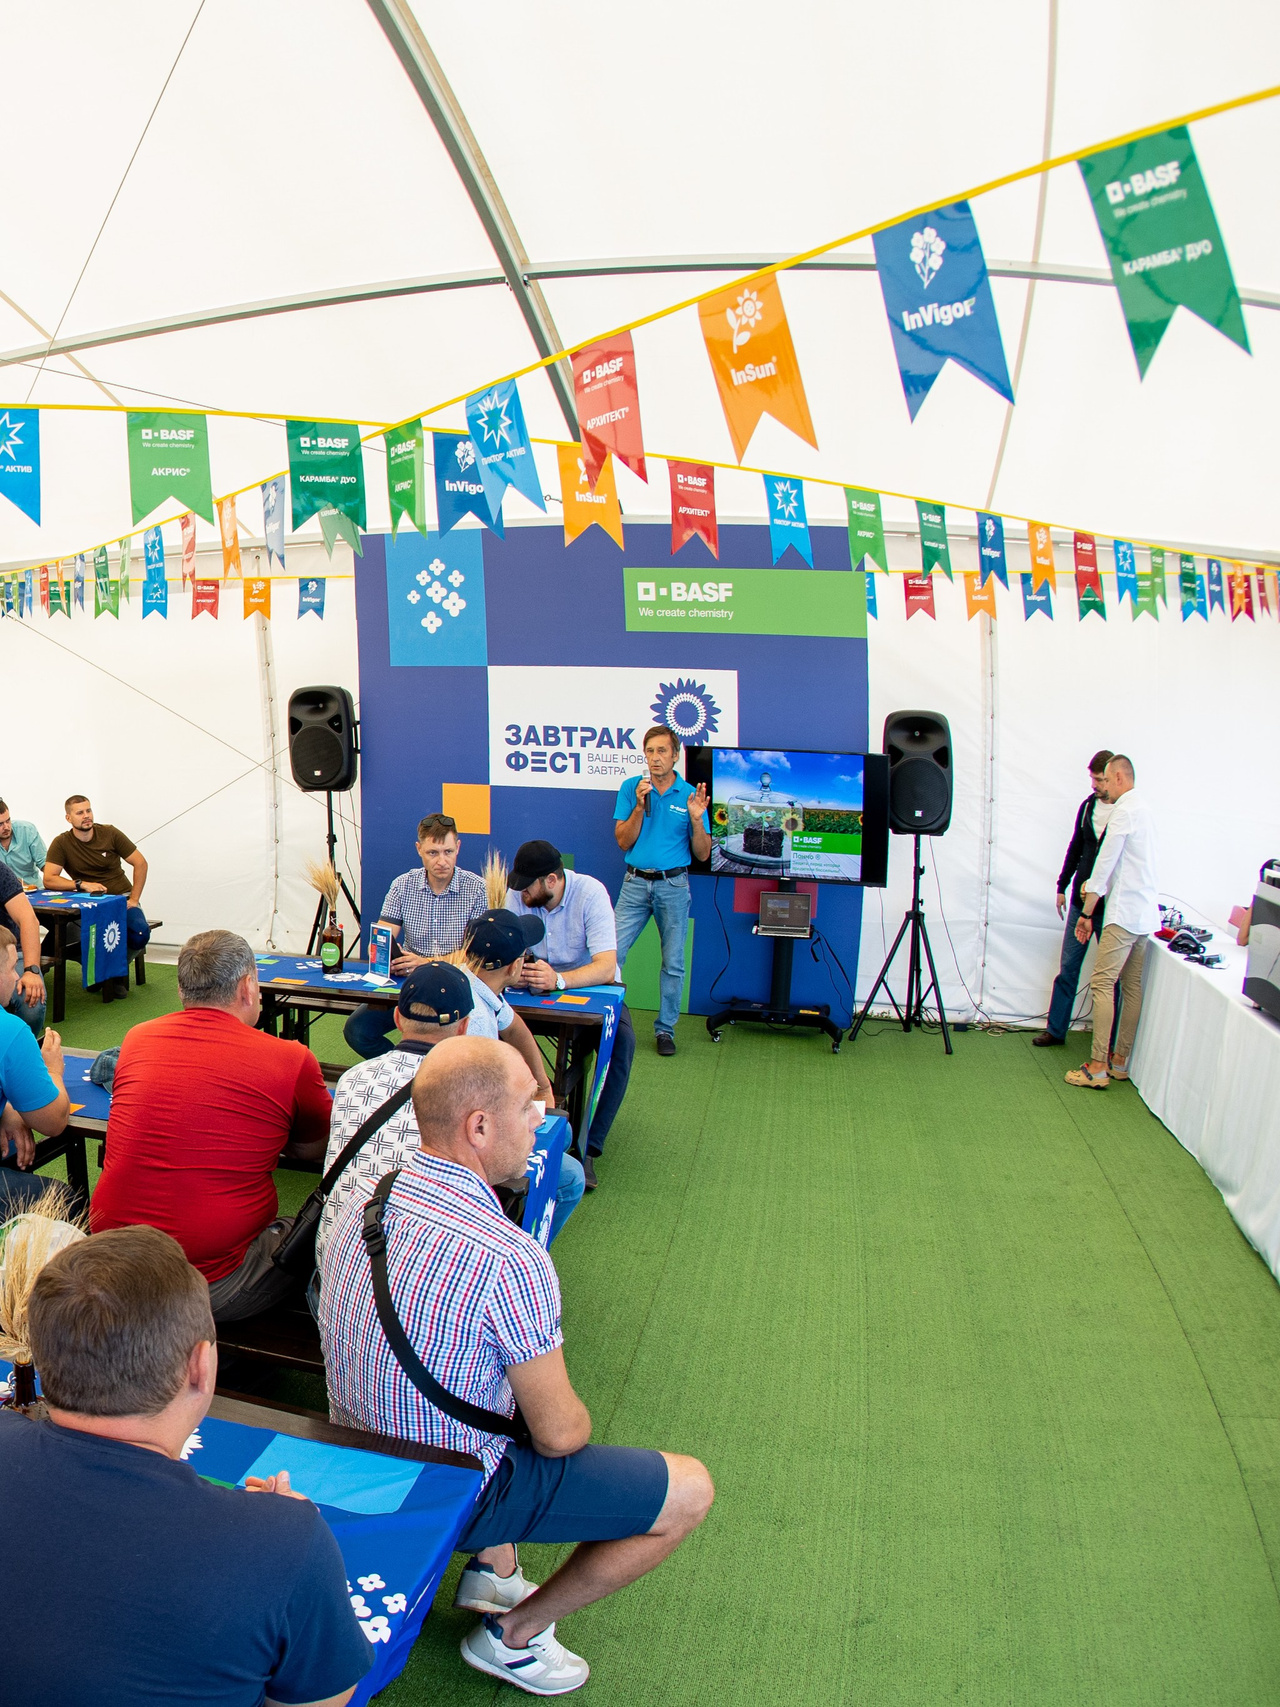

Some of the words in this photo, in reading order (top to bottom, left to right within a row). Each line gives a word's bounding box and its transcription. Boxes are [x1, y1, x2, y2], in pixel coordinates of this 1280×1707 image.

[1134, 161, 1181, 196] BASF
[1185, 239, 1212, 260] ДУО
[596, 357, 624, 378] BASF
[160, 429, 194, 440] BASF
[317, 437, 349, 448] BASF
[396, 439, 416, 453] BASF
[506, 447, 526, 460] АКТИВ
[5, 464, 33, 473] АКТИВ
[340, 476, 357, 484] ДУО
[687, 475, 707, 487] BASF
[445, 480, 485, 495] InVigo
[859, 503, 876, 512] BASF
[670, 582, 733, 603] BASF
[638, 607, 654, 617] We
[656, 608, 686, 618] create
[687, 607, 734, 620] chemistry
[505, 724, 637, 750] ЗАВТРАК
[587, 753, 619, 764] ВАШЕ
[587, 766, 627, 776] ЗАВТРА
[803, 836, 823, 844] BASF
